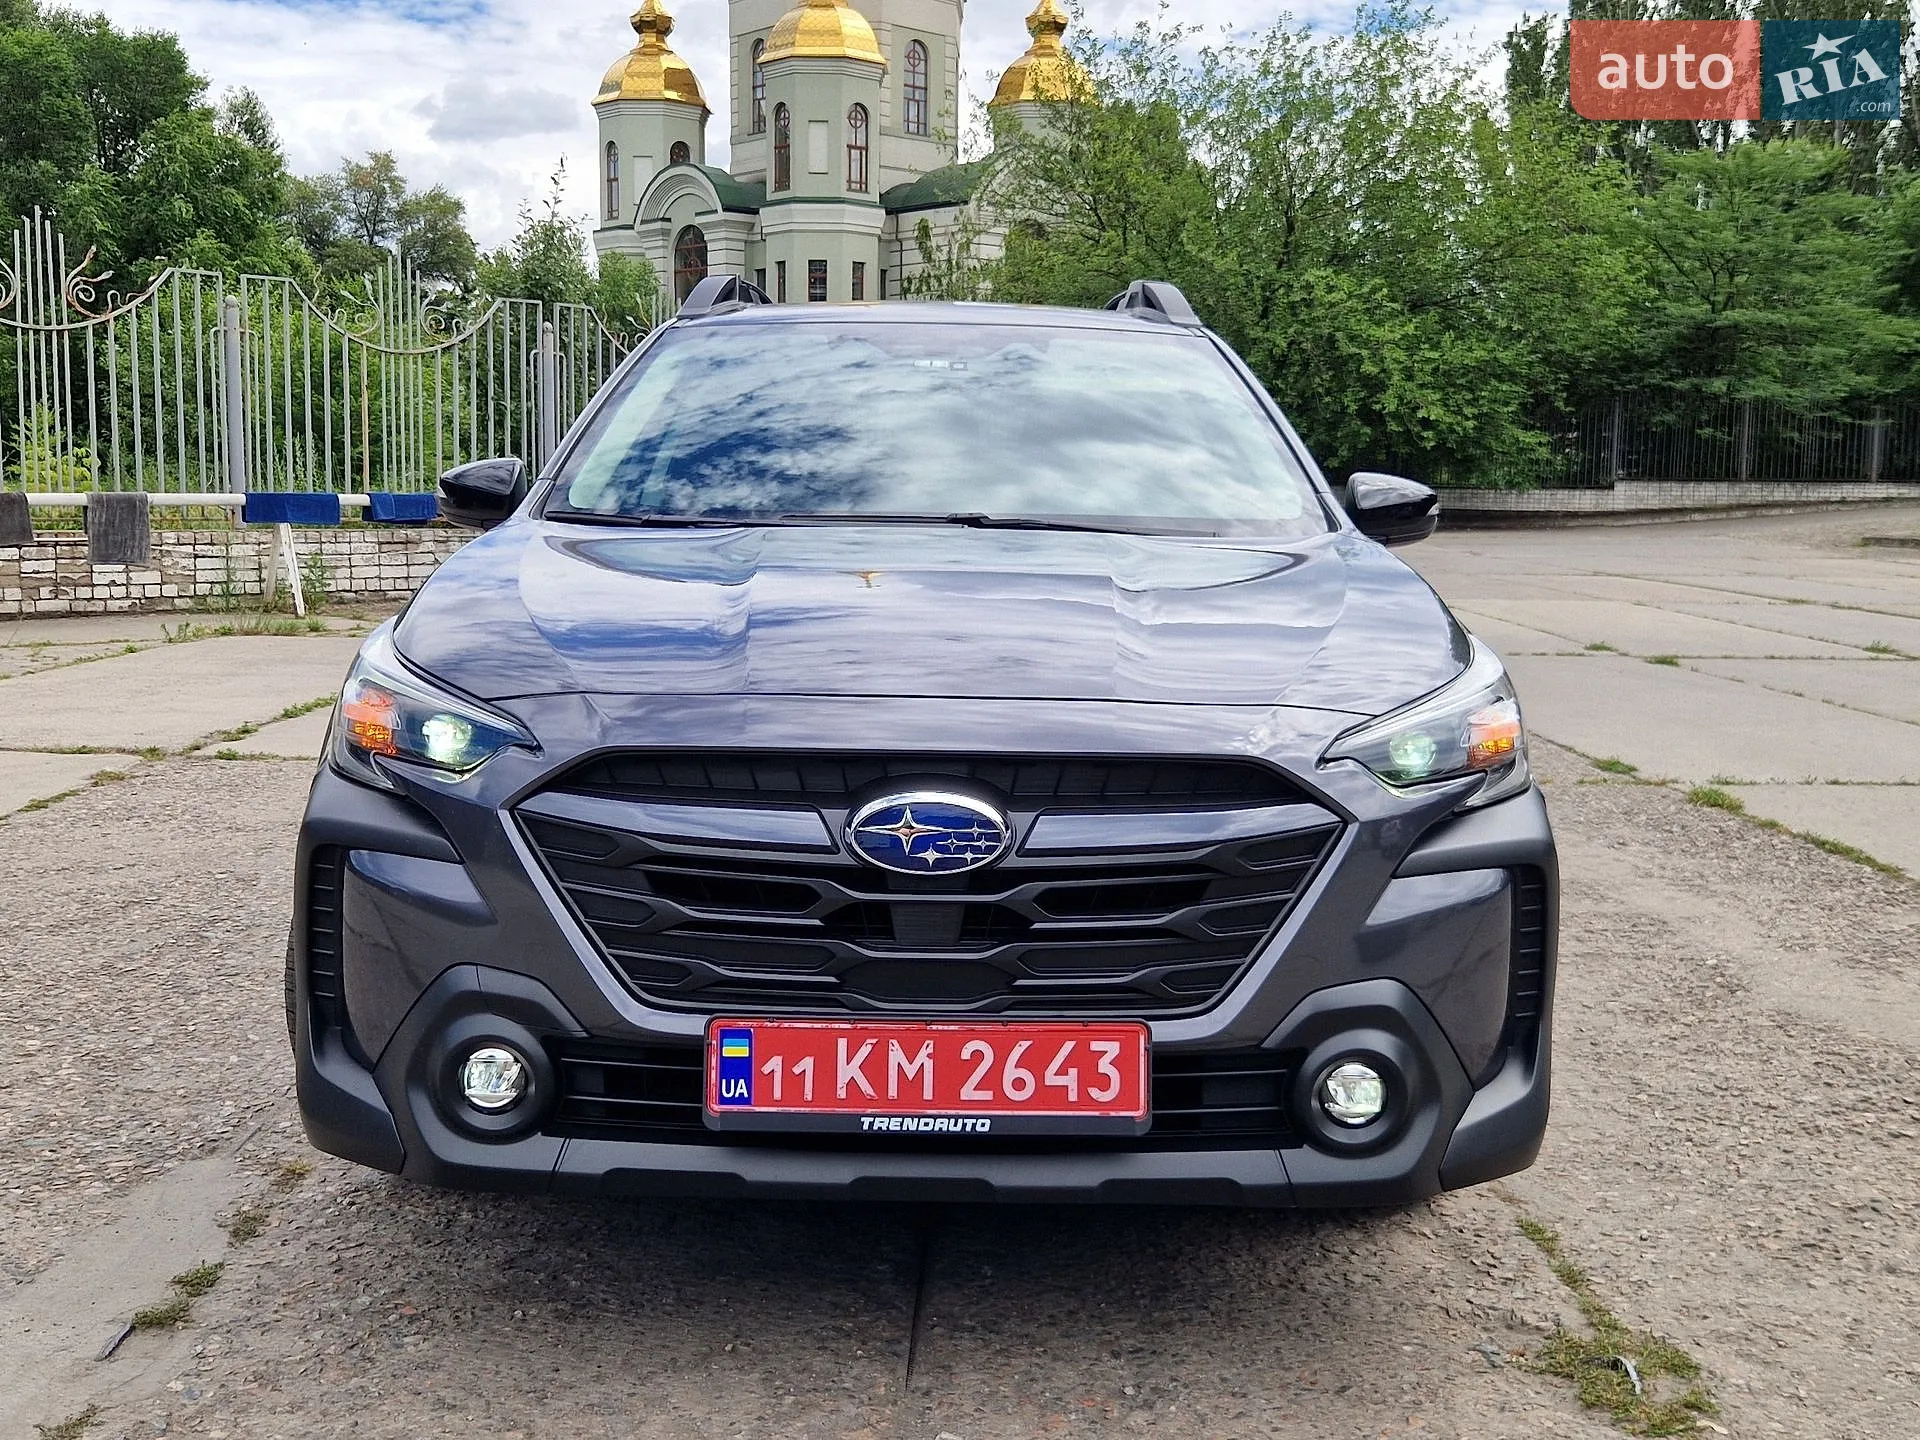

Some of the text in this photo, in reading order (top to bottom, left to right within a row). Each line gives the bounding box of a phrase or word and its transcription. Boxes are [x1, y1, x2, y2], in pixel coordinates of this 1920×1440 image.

[760, 1038, 1121, 1102] 11 KM 2643
[721, 1079, 749, 1098] UA
[860, 1116, 991, 1132] TRENDAUTO
